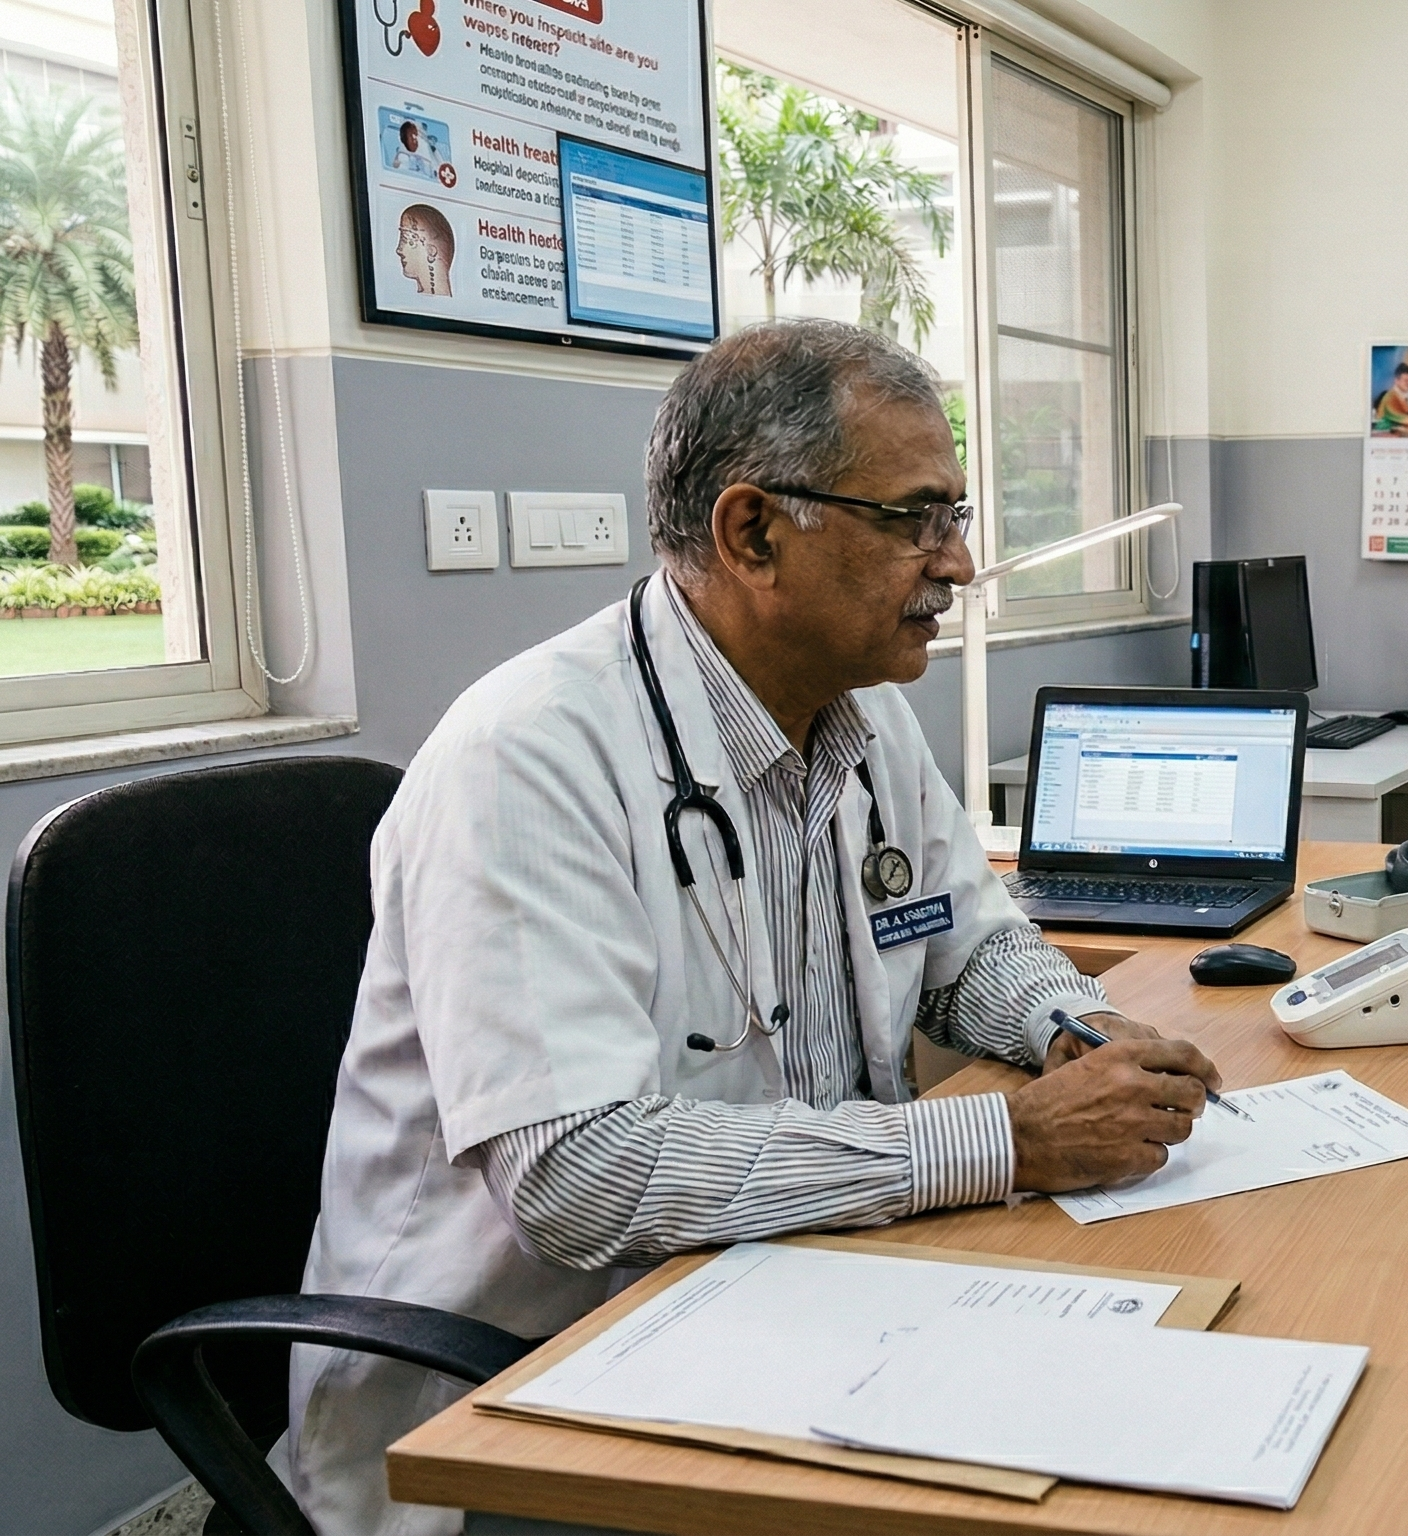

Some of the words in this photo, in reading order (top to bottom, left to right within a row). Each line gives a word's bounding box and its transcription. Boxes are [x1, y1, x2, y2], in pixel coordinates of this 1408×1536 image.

[510, 10, 534, 27] you
[615, 47, 636, 63] are
[637, 53, 659, 71] you
[473, 129, 520, 157] Health
[523, 142, 559, 166] treat
[478, 218, 525, 244] Health
